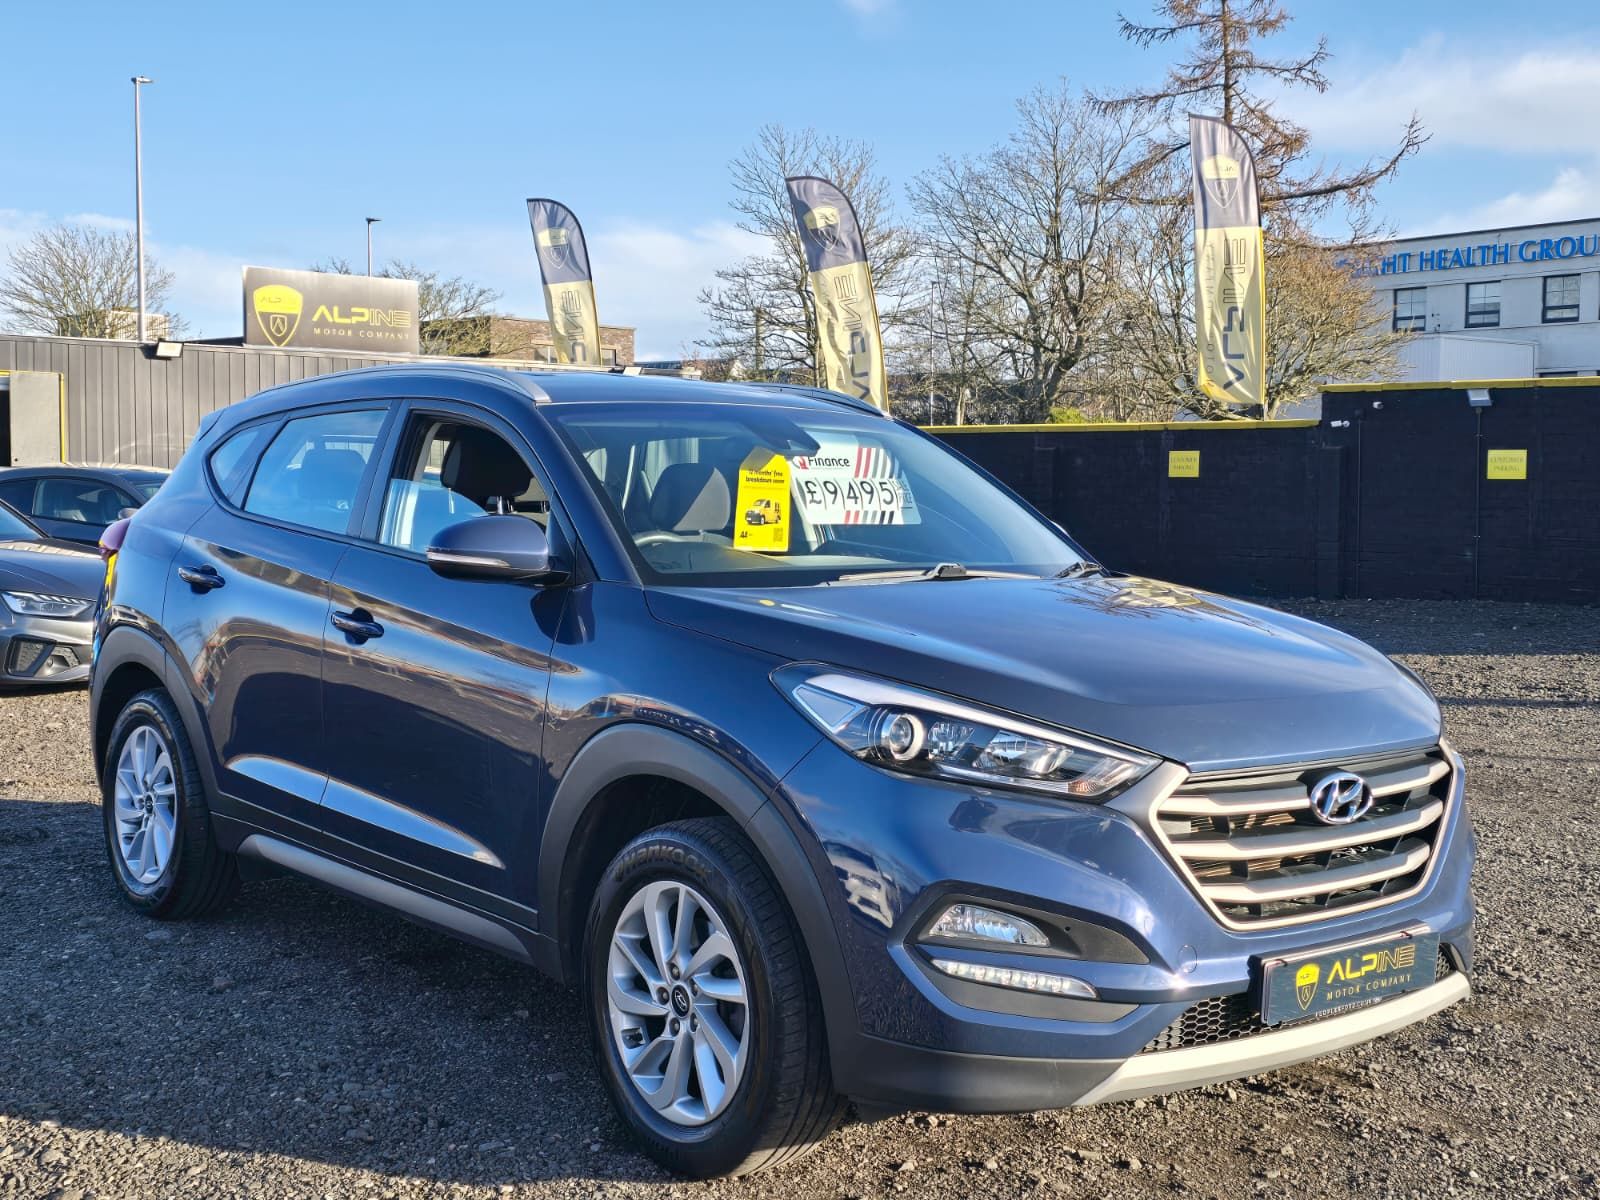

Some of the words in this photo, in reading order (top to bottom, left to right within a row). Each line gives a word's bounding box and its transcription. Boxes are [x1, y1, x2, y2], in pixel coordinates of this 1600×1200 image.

[1419, 243, 1509, 272] HEALTH
[312, 304, 411, 328] ALPINE
[1223, 238, 1246, 391] ALPINE
[314, 327, 352, 337] MOTOR
[359, 329, 409, 340] COMPANY
[808, 456, 851, 467] Finance
[805, 480, 894, 505] £9495
[1327, 943, 1416, 985] ALPINE
[1326, 985, 1361, 1001] MOTOR
[1366, 974, 1412, 991] COMPANY
